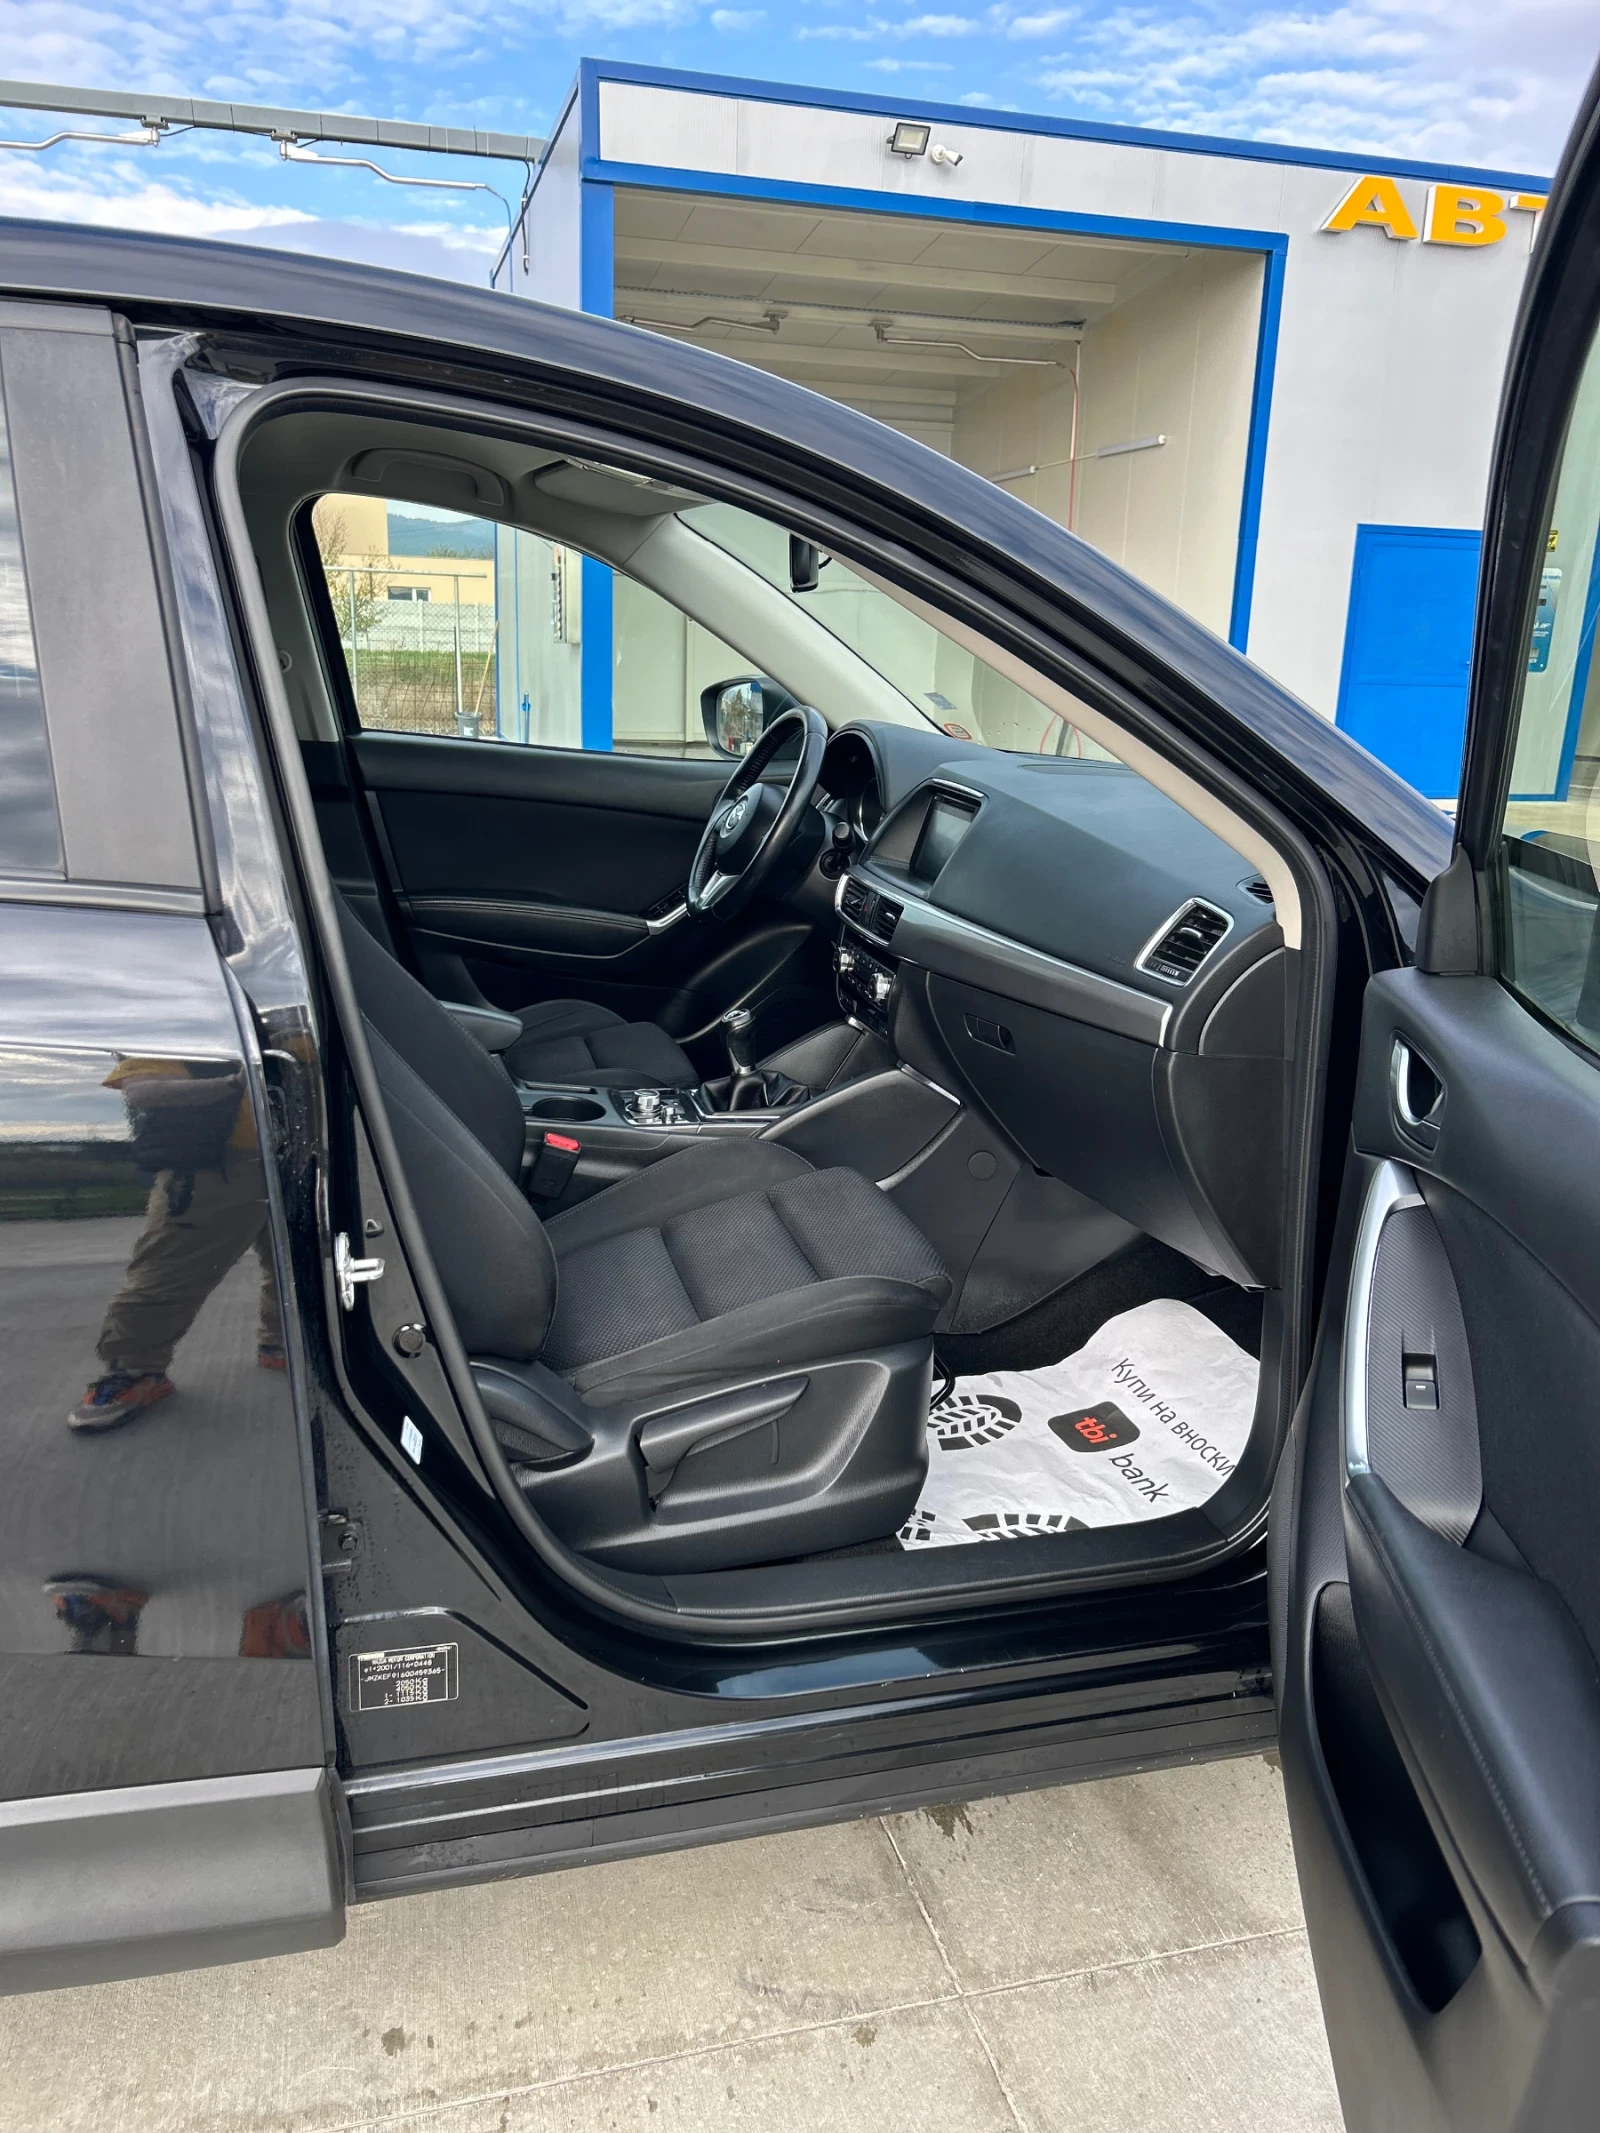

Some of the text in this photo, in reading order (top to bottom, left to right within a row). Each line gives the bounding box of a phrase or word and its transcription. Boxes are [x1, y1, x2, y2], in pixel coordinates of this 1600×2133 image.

[1074, 1416, 1170, 1503] tbi bank
[1111, 1357, 1236, 1477] Купи на вноски
